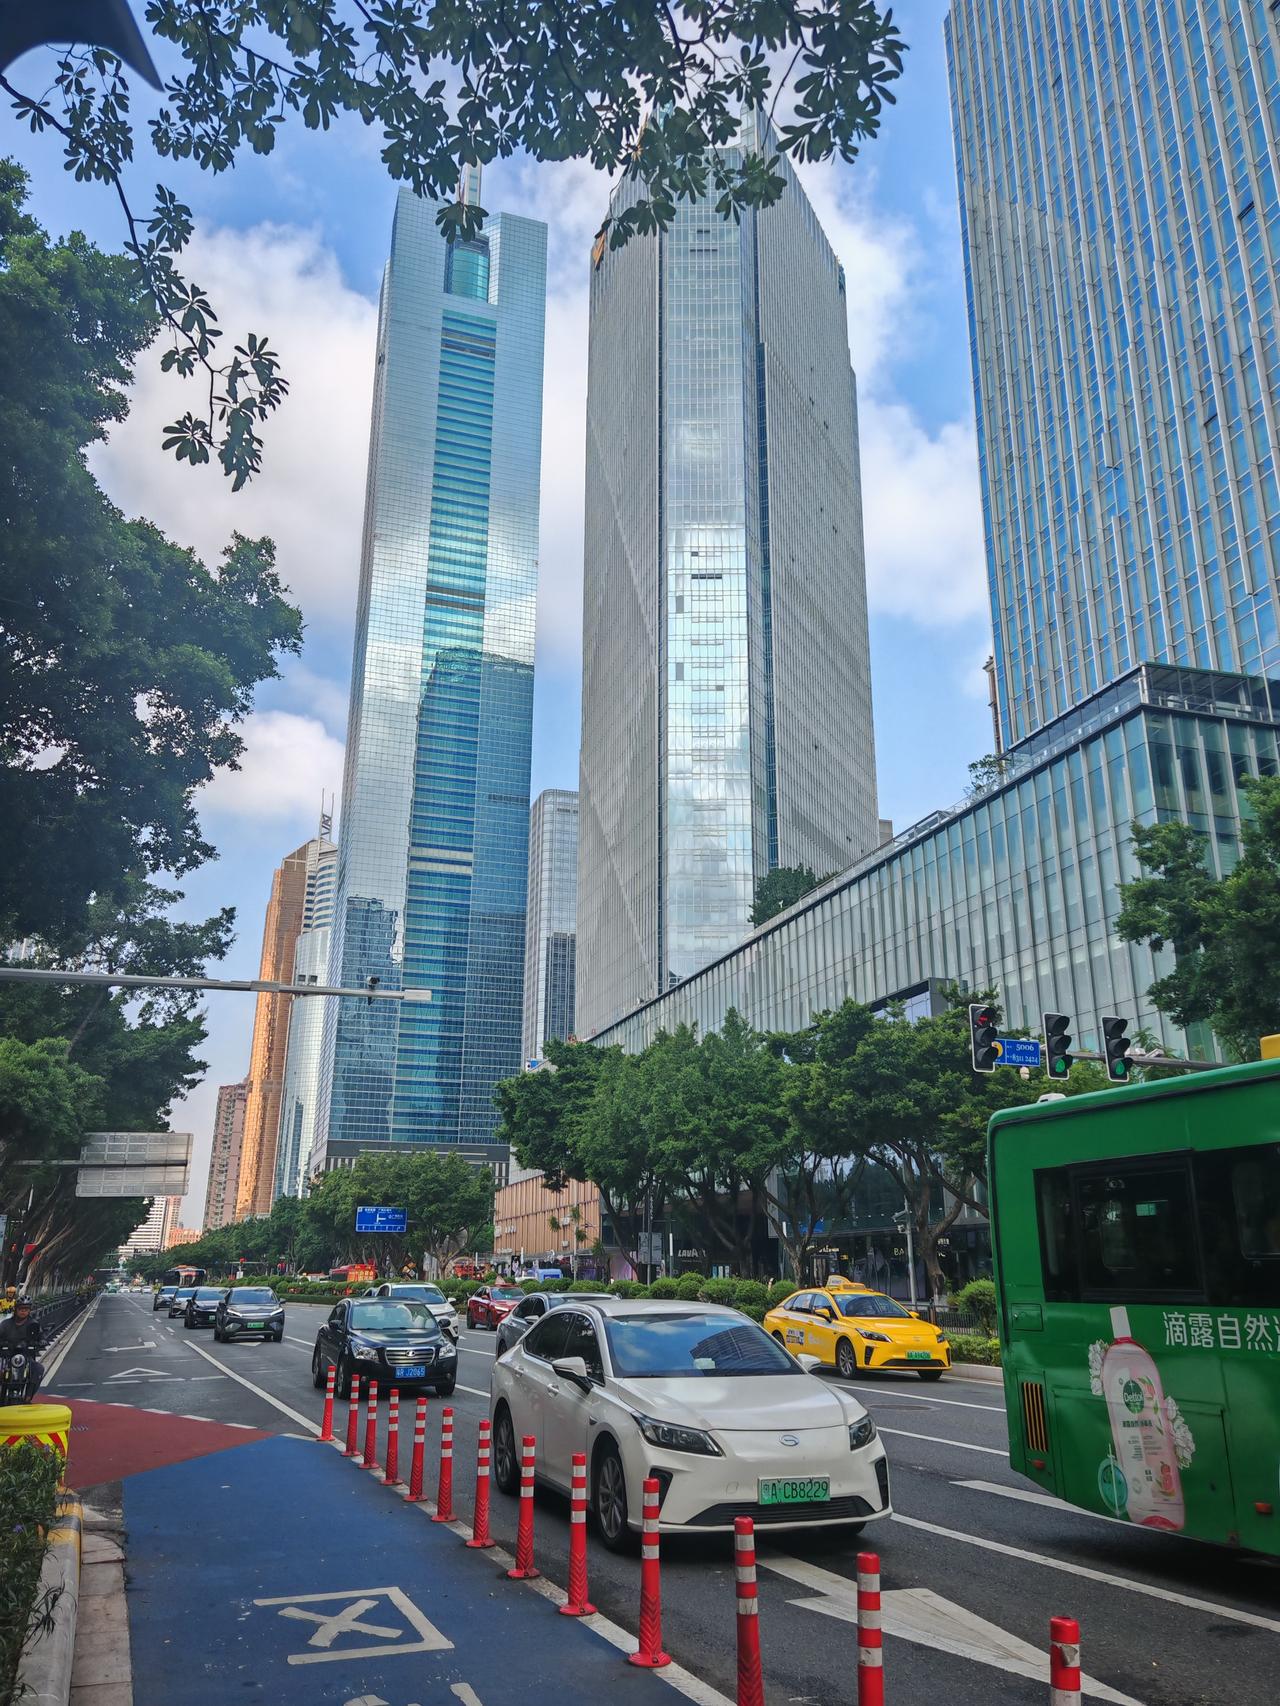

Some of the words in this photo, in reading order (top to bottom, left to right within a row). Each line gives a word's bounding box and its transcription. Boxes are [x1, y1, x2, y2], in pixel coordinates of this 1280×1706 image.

[1016, 1043, 1034, 1051] 5006
[1162, 1311, 1280, 1352] 滴露自然
[1124, 1391, 1143, 1402] Dettol
